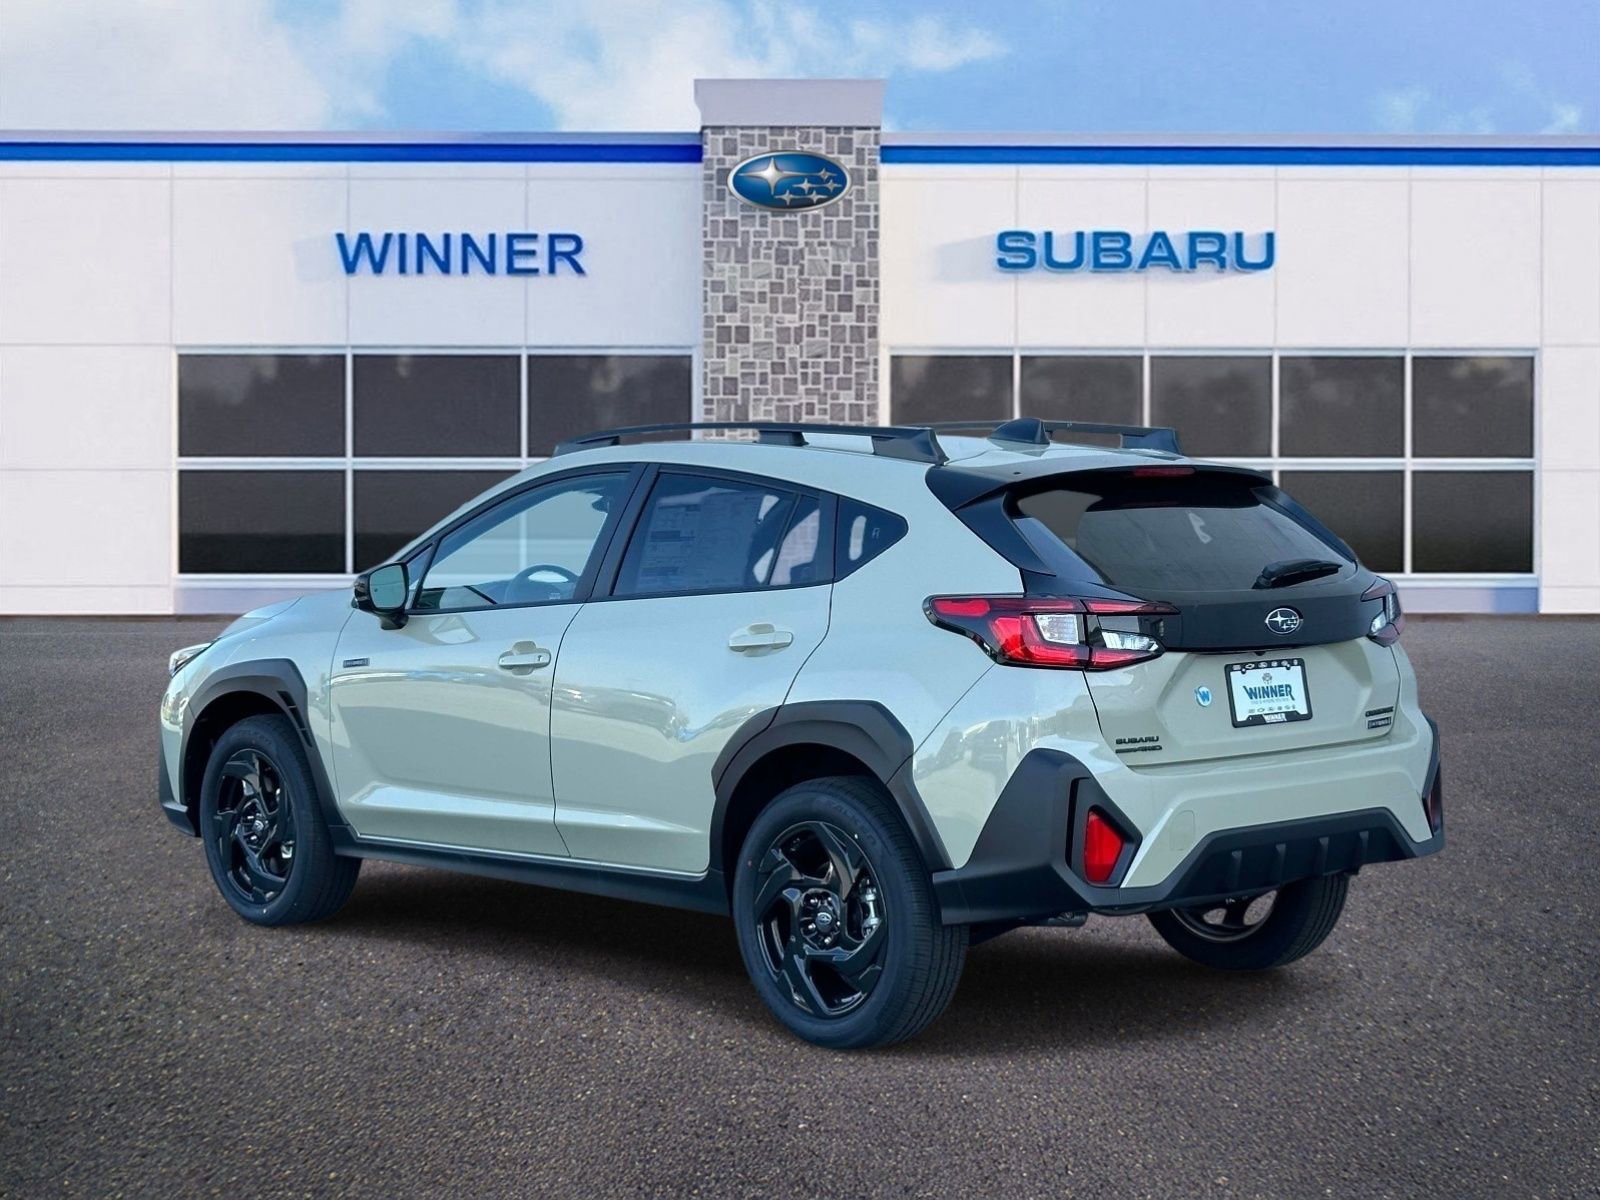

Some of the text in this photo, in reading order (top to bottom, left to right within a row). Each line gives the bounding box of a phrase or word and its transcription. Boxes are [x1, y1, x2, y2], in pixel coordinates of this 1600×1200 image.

[335, 232, 587, 275] WINNER
[996, 230, 1275, 270] SUBARU
[1243, 684, 1295, 702] WINNER
[1115, 735, 1160, 744] SUBARU
